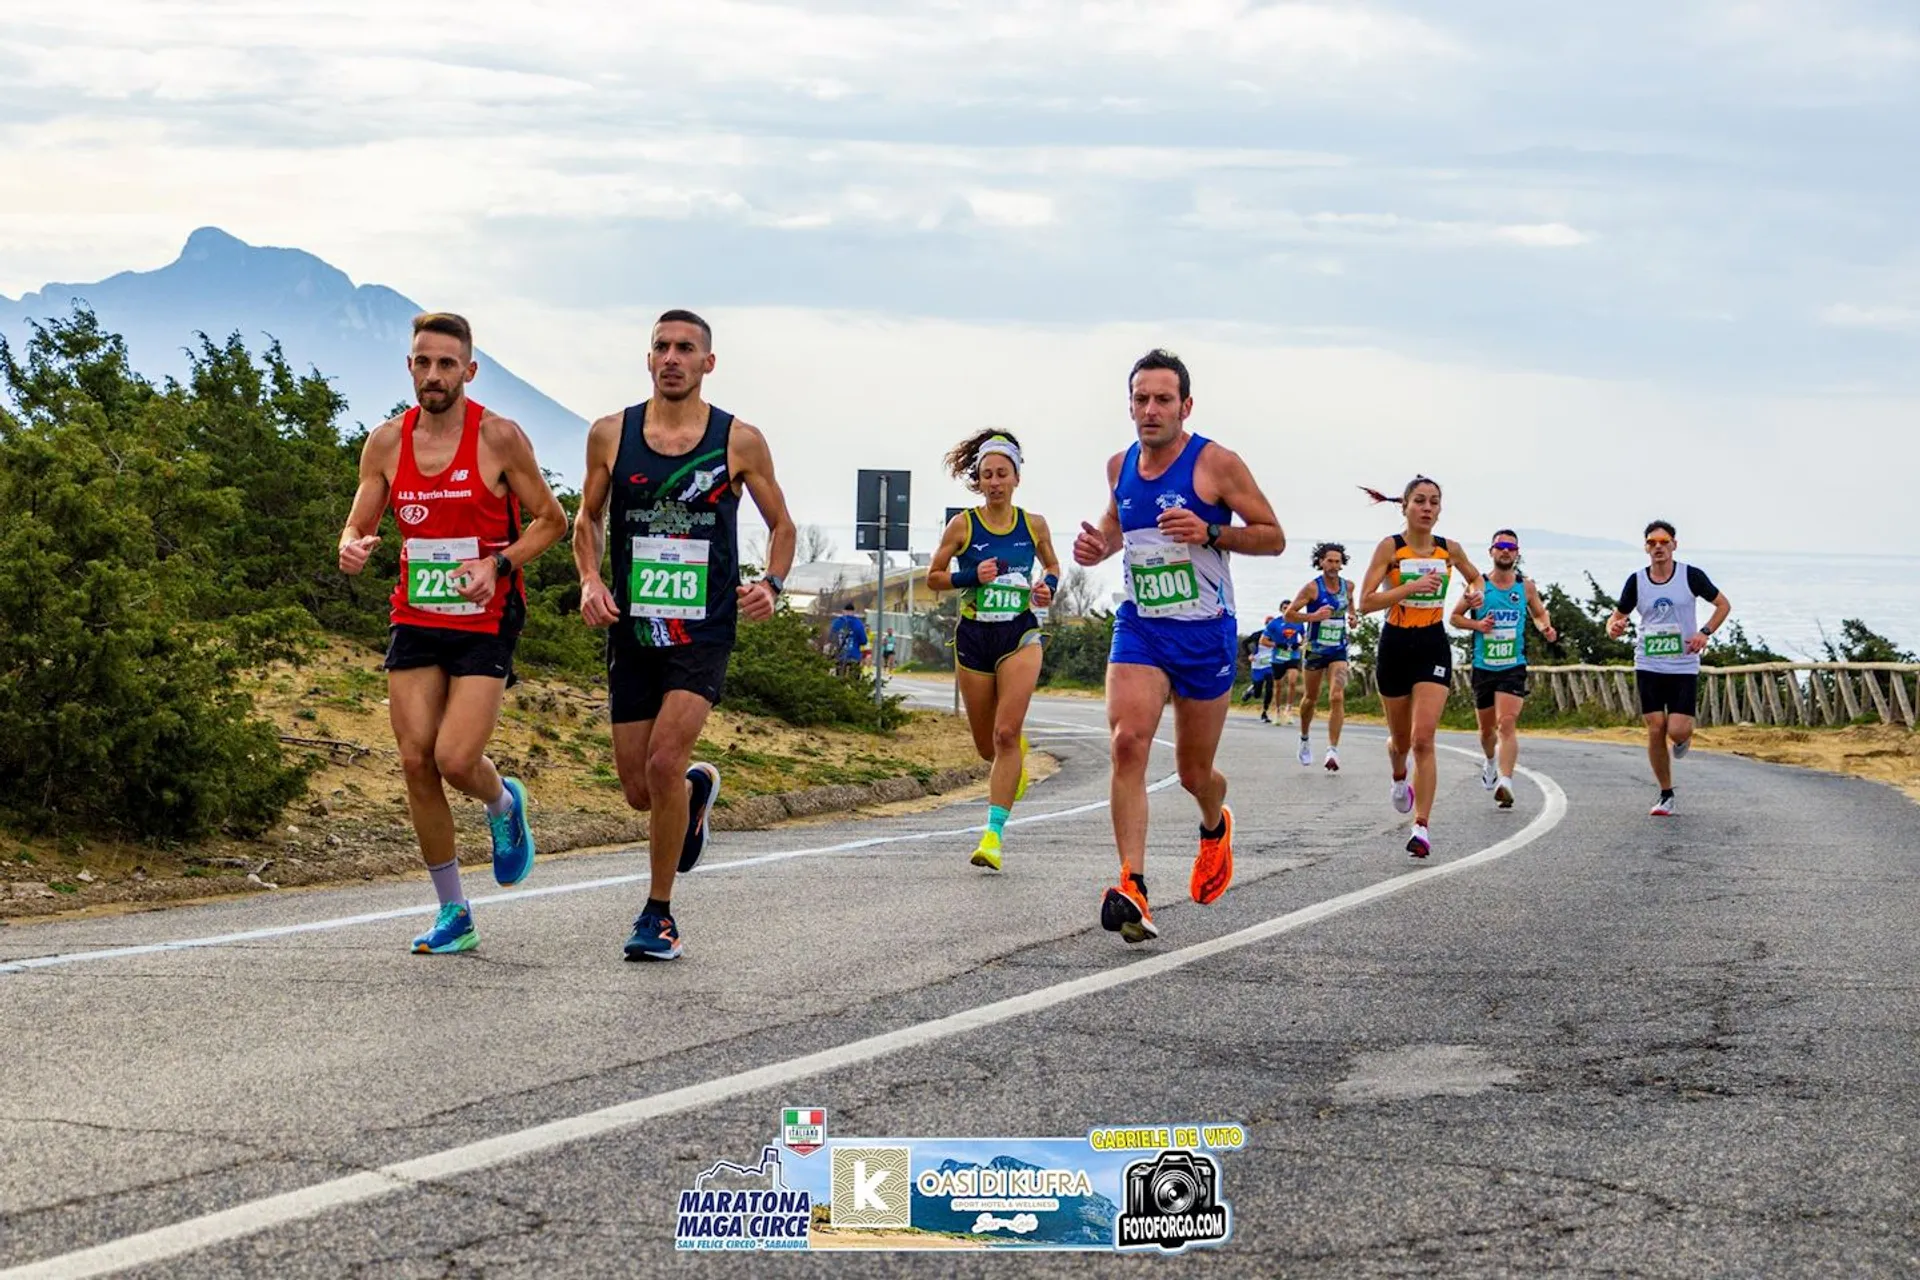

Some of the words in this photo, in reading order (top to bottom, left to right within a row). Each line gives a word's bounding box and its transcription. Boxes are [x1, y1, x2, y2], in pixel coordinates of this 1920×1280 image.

[639, 568, 698, 600] 2213
[1135, 569, 1192, 600] 2300
[1487, 642, 1514, 657] 2187
